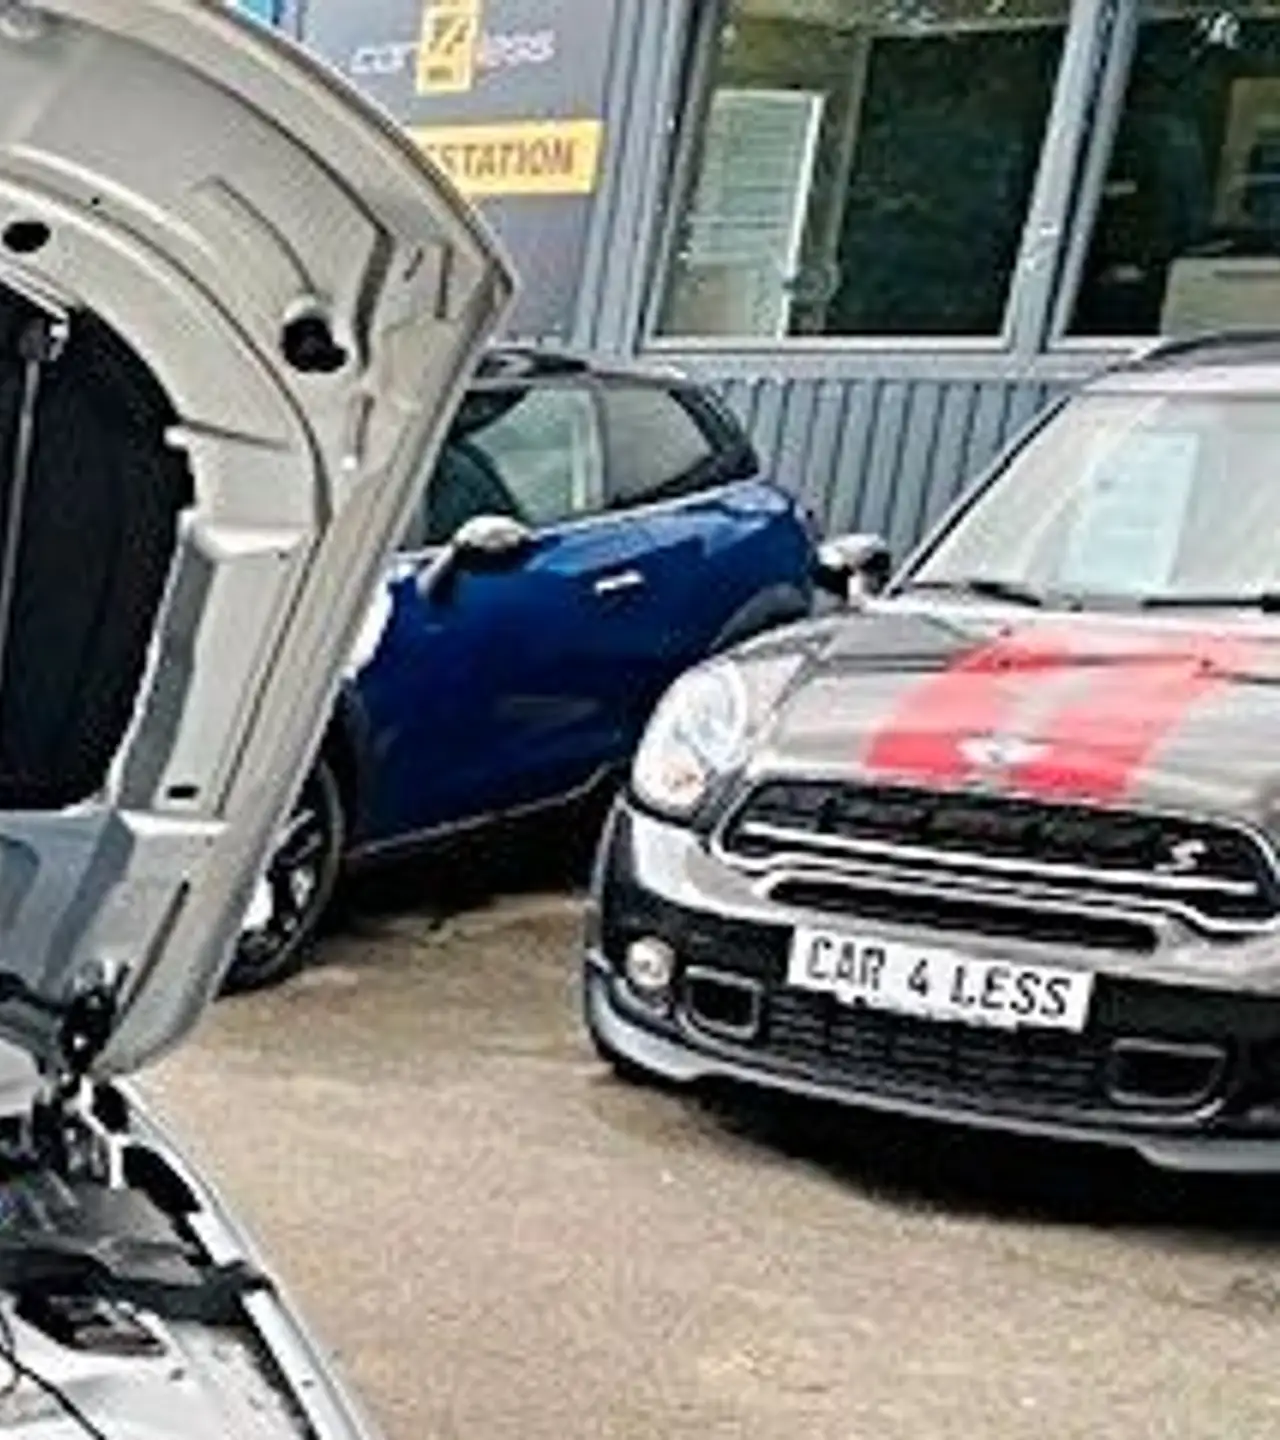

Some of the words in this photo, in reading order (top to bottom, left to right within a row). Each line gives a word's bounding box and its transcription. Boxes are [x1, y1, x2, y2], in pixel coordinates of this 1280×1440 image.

[425, 136, 577, 177] STATION
[806, 936, 886, 991] CAR
[907, 958, 930, 997] 4
[950, 964, 1072, 1016] LESS
